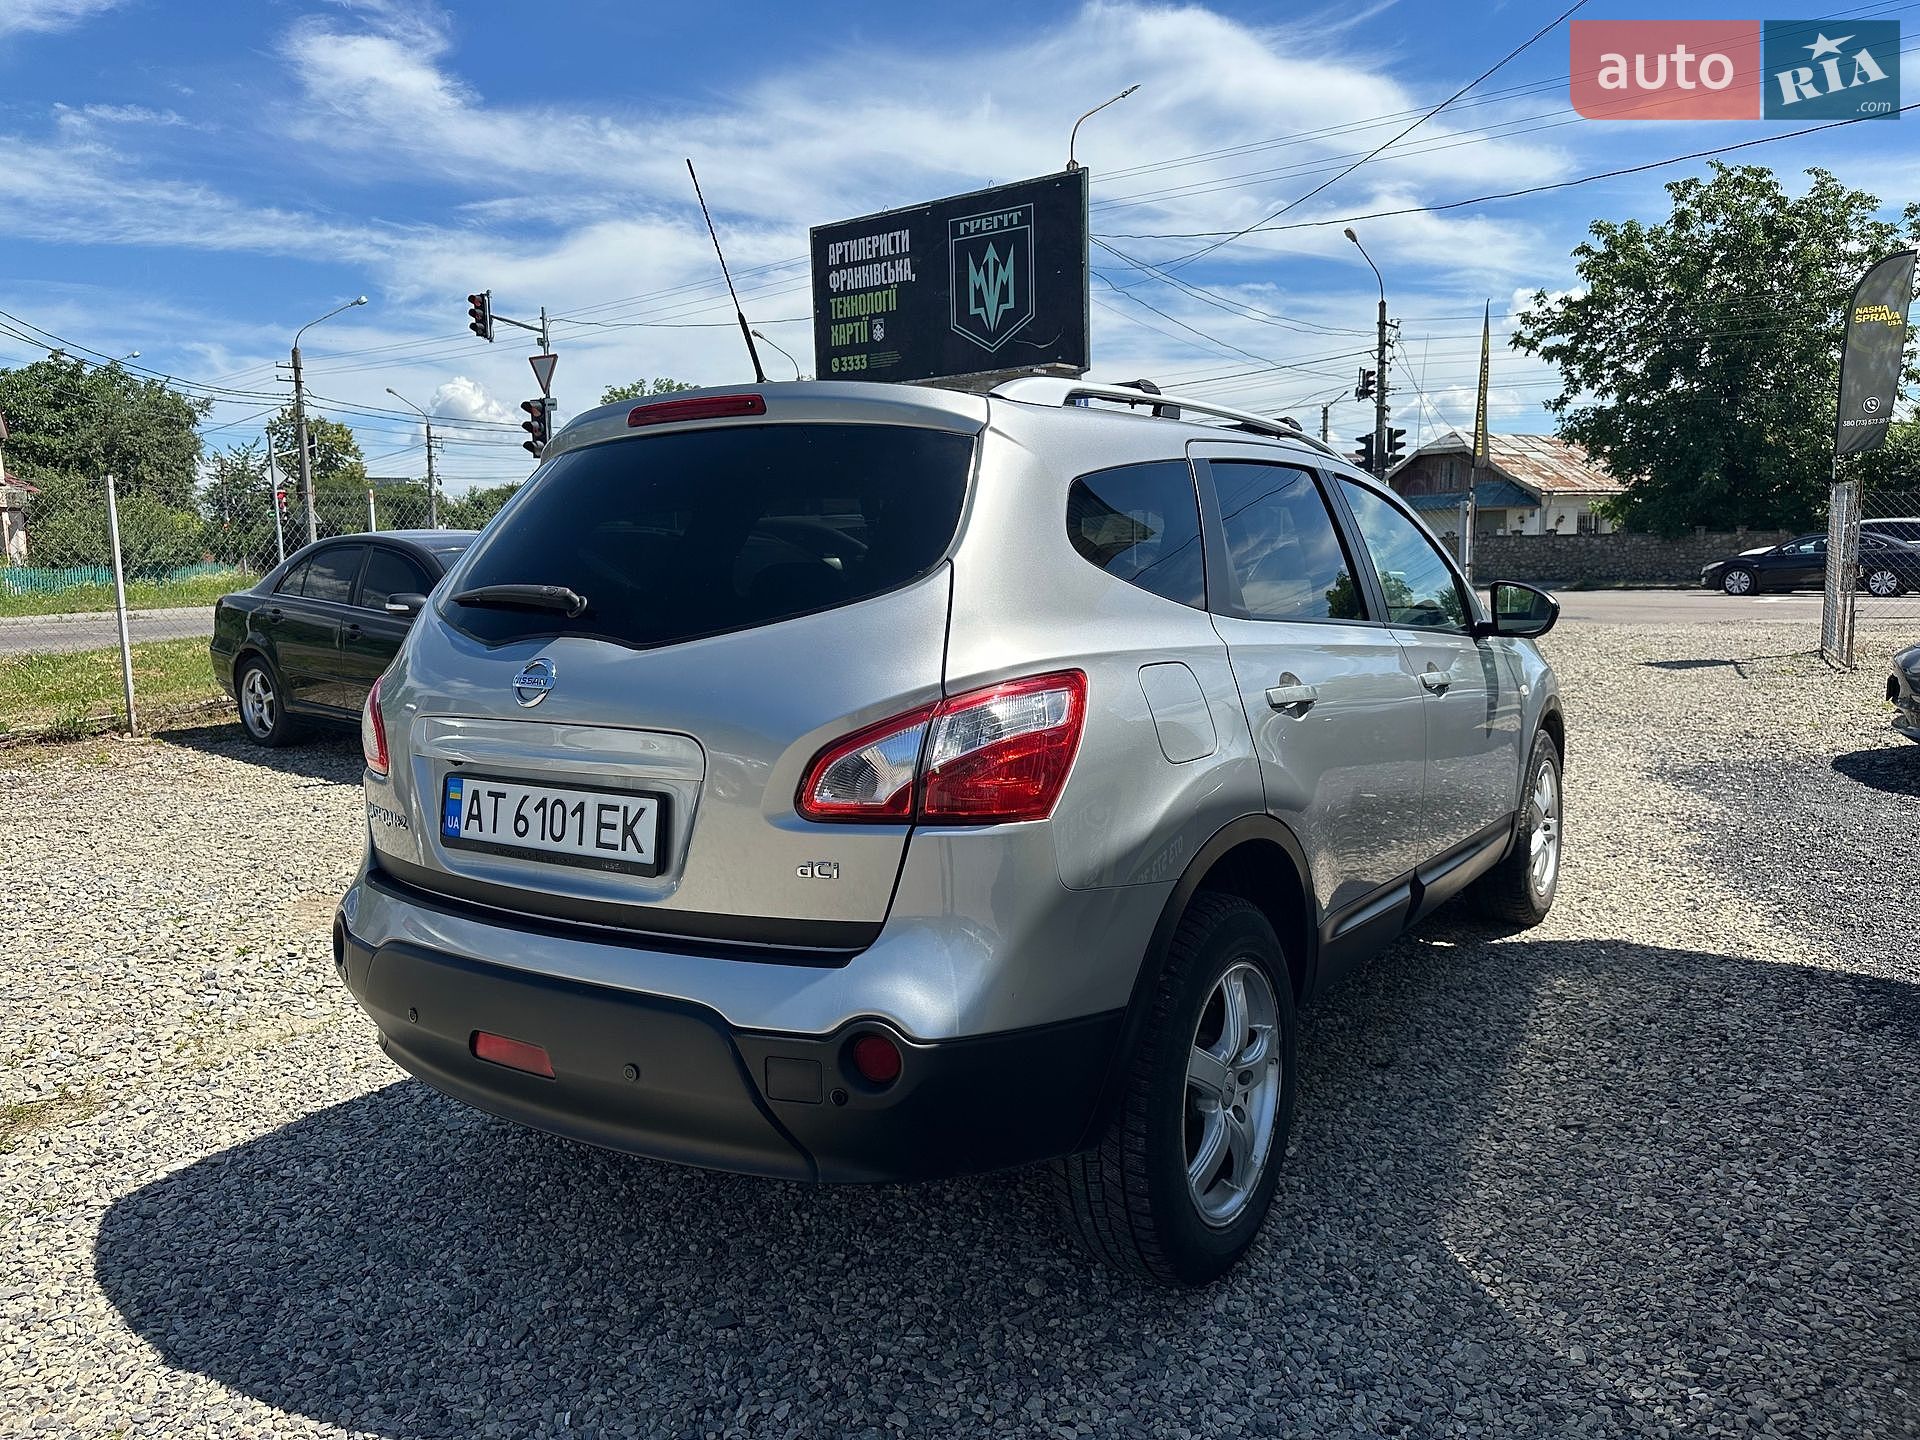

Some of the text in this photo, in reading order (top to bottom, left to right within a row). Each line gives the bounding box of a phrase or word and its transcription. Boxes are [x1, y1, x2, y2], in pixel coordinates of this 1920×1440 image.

[828, 229, 910, 266] АРТИЛЕРИСТИ
[828, 258, 916, 292] ФРАНКІВСЬКА,
[829, 284, 898, 319] ТЕХНОЛОГІЇ
[1855, 305, 1888, 315] NASHA
[1855, 311, 1901, 323] SPRAVA
[831, 316, 869, 347] ХАРТІЇ
[840, 354, 867, 372] 3333
[447, 789, 647, 854] UA AT 6101 EK
[796, 861, 840, 879] dCi
